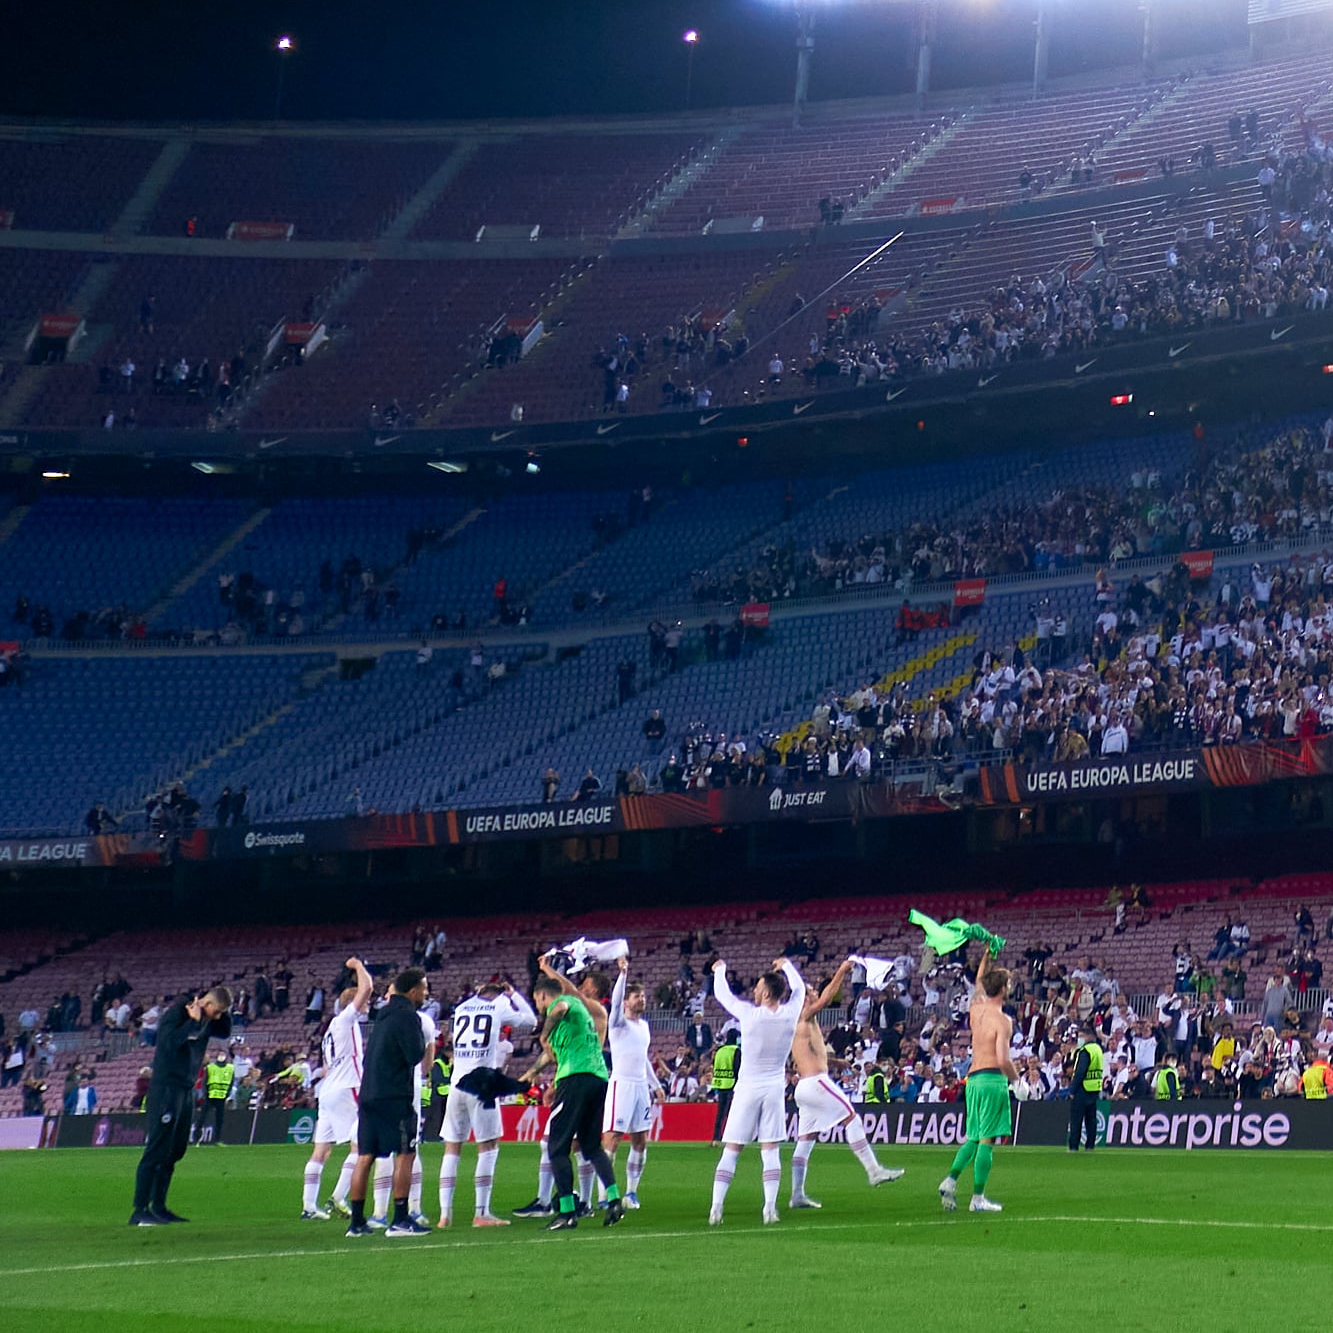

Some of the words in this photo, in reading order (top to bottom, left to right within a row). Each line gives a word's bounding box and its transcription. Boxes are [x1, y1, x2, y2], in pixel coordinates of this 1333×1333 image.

[1027, 772, 1067, 791] UEFA
[1071, 766, 1130, 789] EUROPA
[1134, 759, 1194, 783] LEAGUE
[784, 793, 806, 808] JUST
[807, 791, 826, 805] EAT
[466, 814, 501, 833] UEFA
[503, 810, 557, 831] EUROPA
[558, 806, 612, 827] LEAGUE
[17, 842, 87, 861] LEAGUE
[254, 832, 305, 847] Swissquote
[455, 1014, 493, 1048] 29
[895, 1112, 967, 1144] LEAGU
